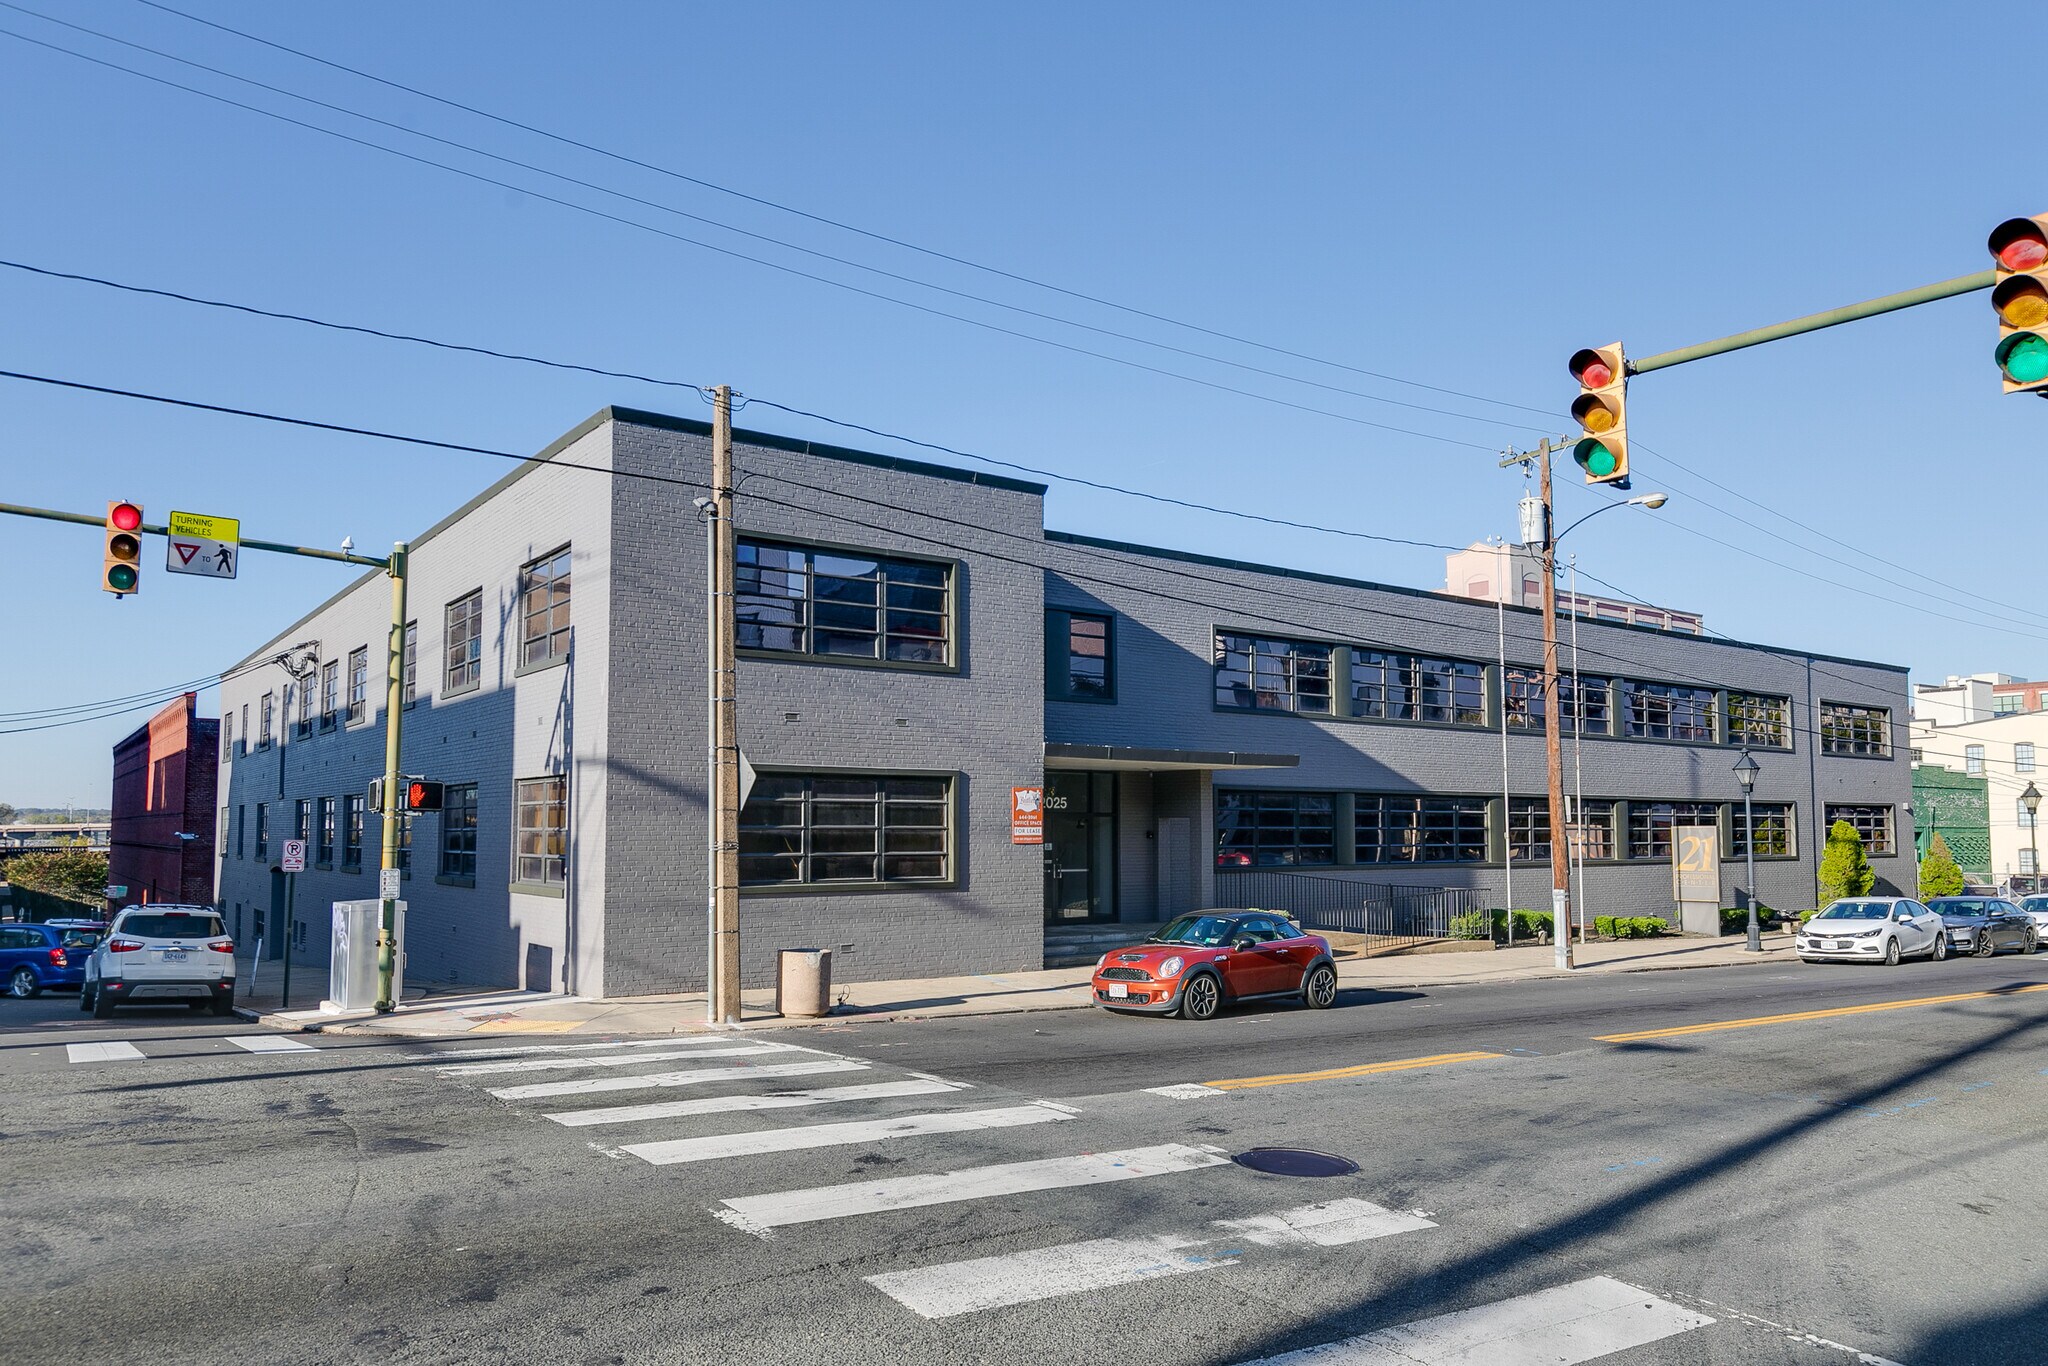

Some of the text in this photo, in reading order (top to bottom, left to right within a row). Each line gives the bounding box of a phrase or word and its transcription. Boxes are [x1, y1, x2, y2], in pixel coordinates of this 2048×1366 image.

[176, 515, 213, 527] TURNING
[175, 525, 212, 536] VEHICLES
[202, 555, 211, 563] TO
[1675, 835, 1715, 872] 21
